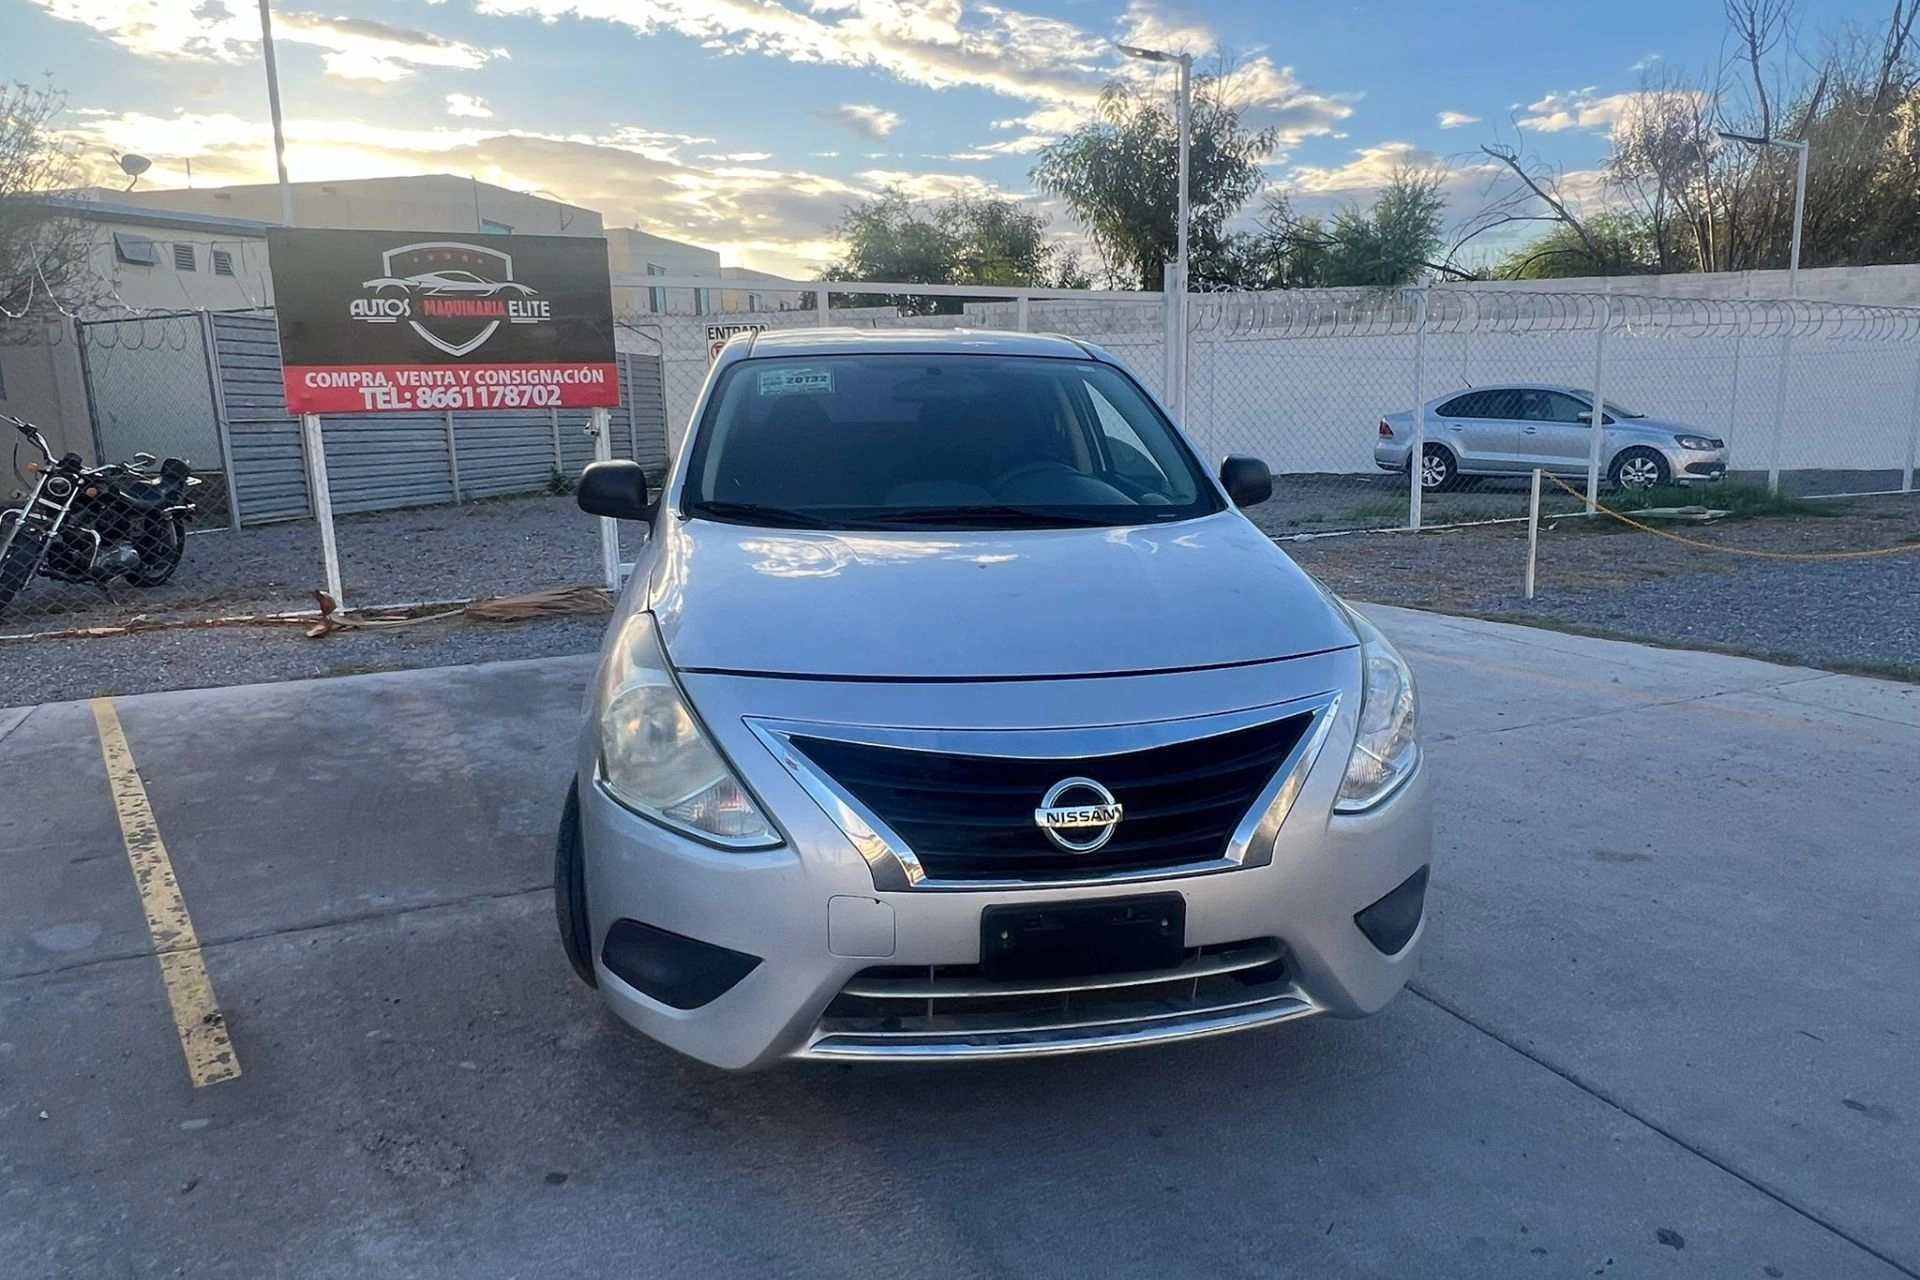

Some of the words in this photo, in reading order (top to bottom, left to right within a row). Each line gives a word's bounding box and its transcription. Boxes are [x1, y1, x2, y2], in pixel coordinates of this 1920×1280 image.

[350, 299, 411, 317] AUTOS
[423, 300, 506, 318] MAQUINARIA
[508, 300, 551, 317] ELITE
[304, 371, 393, 388] COMPRA,
[396, 371, 456, 386] VENTA
[458, 370, 470, 385] Y
[474, 366, 605, 385] CONSIGNACIÓN
[359, 386, 413, 409] TEL:
[416, 385, 562, 409] 8661178702
[1046, 808, 1115, 823] NISSAN
